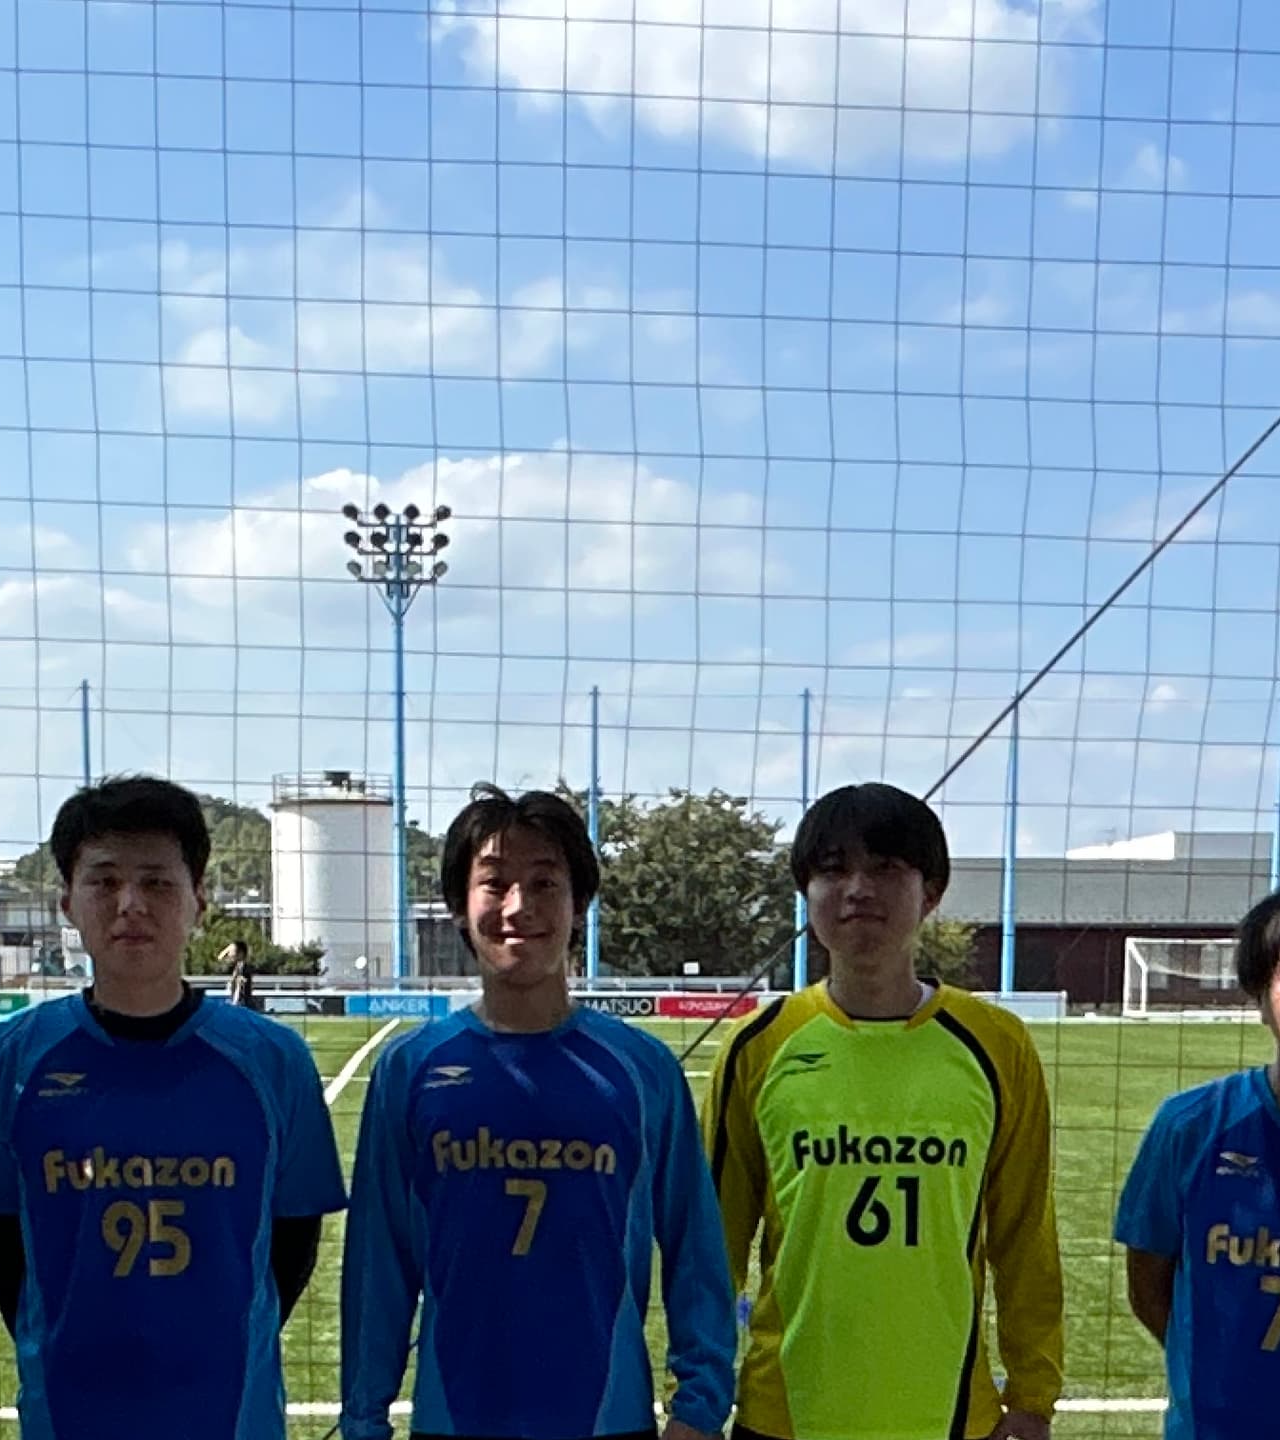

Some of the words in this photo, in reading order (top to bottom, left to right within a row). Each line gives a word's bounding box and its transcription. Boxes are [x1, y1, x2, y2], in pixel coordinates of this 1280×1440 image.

[369, 998, 431, 1013] ANKER
[43, 1146, 236, 1194] Fukazon
[432, 1126, 617, 1174] Fukazon
[792, 1124, 968, 1171] Fukazon
[505, 1178, 548, 1256] 7
[846, 1175, 920, 1247] 61
[101, 1199, 192, 1278] 95
